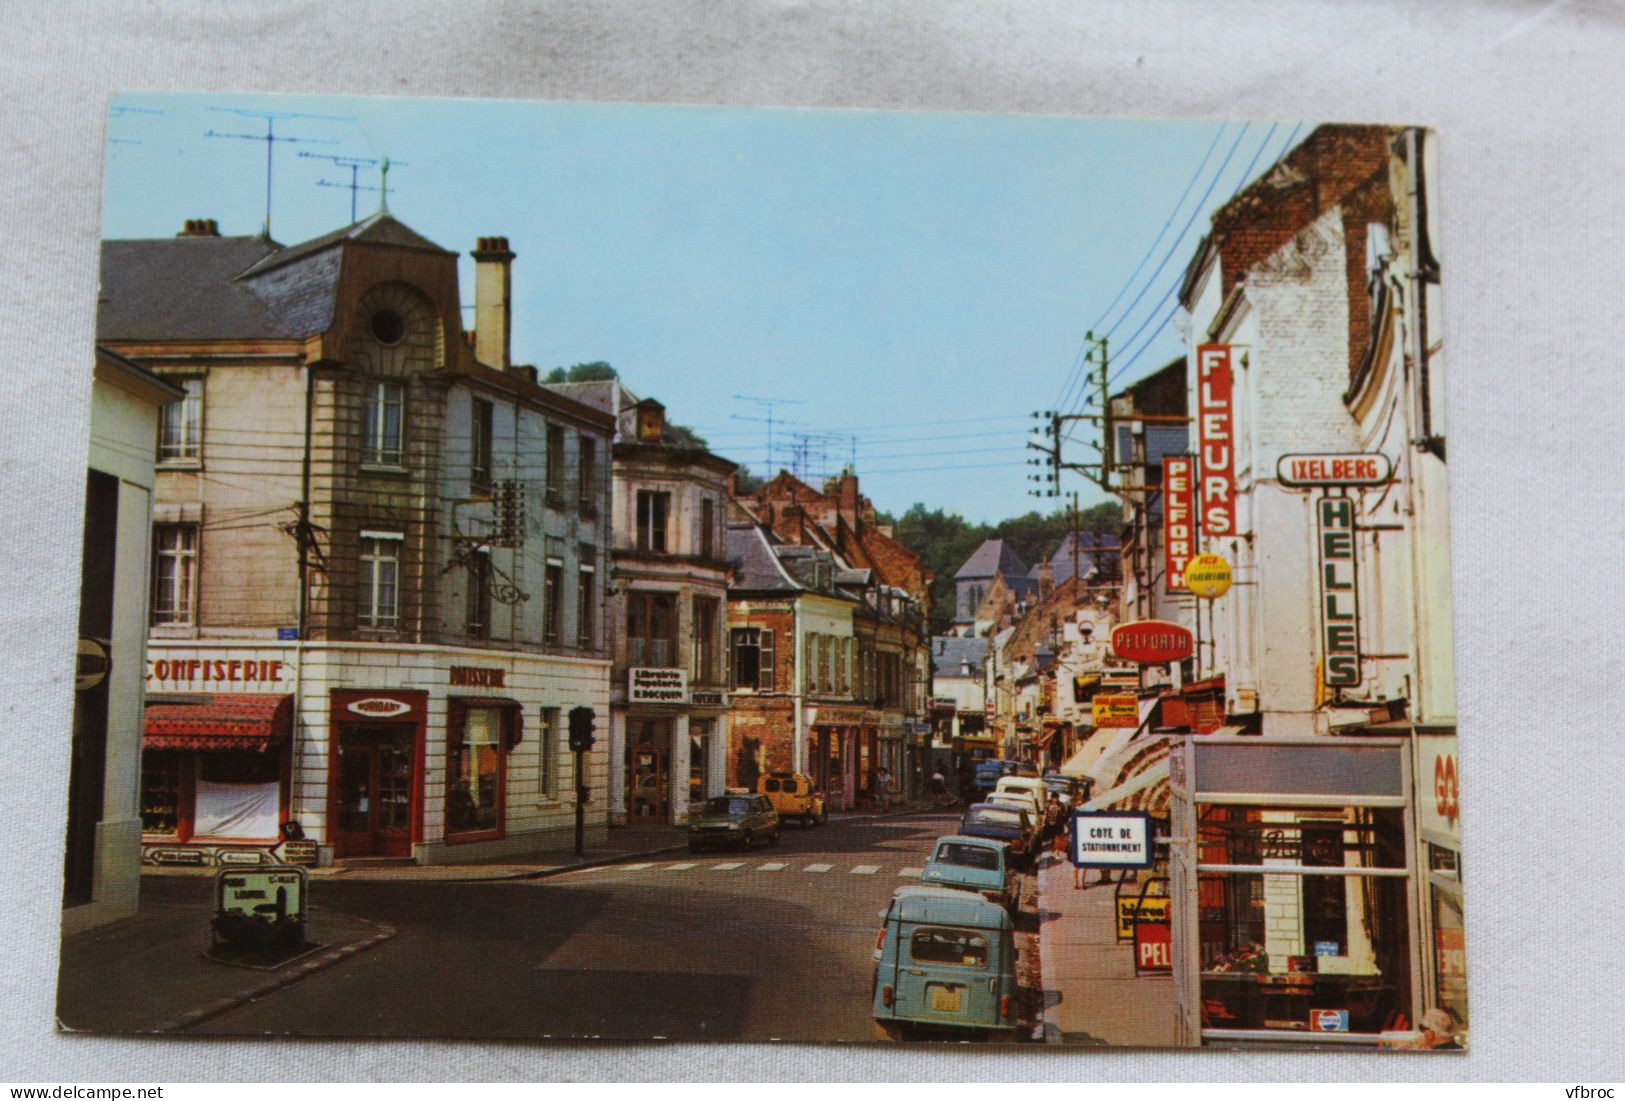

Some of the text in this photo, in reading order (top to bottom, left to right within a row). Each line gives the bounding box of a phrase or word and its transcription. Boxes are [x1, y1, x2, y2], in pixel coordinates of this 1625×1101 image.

[1202, 351, 1231, 533] FLEURS
[1291, 459, 1378, 481] IXELBERG
[1168, 461, 1189, 588] PELFORTH
[1322, 501, 1357, 684] HELLES
[1116, 632, 1188, 650] PELFORTH
[635, 669, 680, 678] Librairie
[634, 679, 682, 687] Papeterie
[1120, 828, 1132, 839] DE
[1082, 842, 1142, 853] STATIONNEMENT
